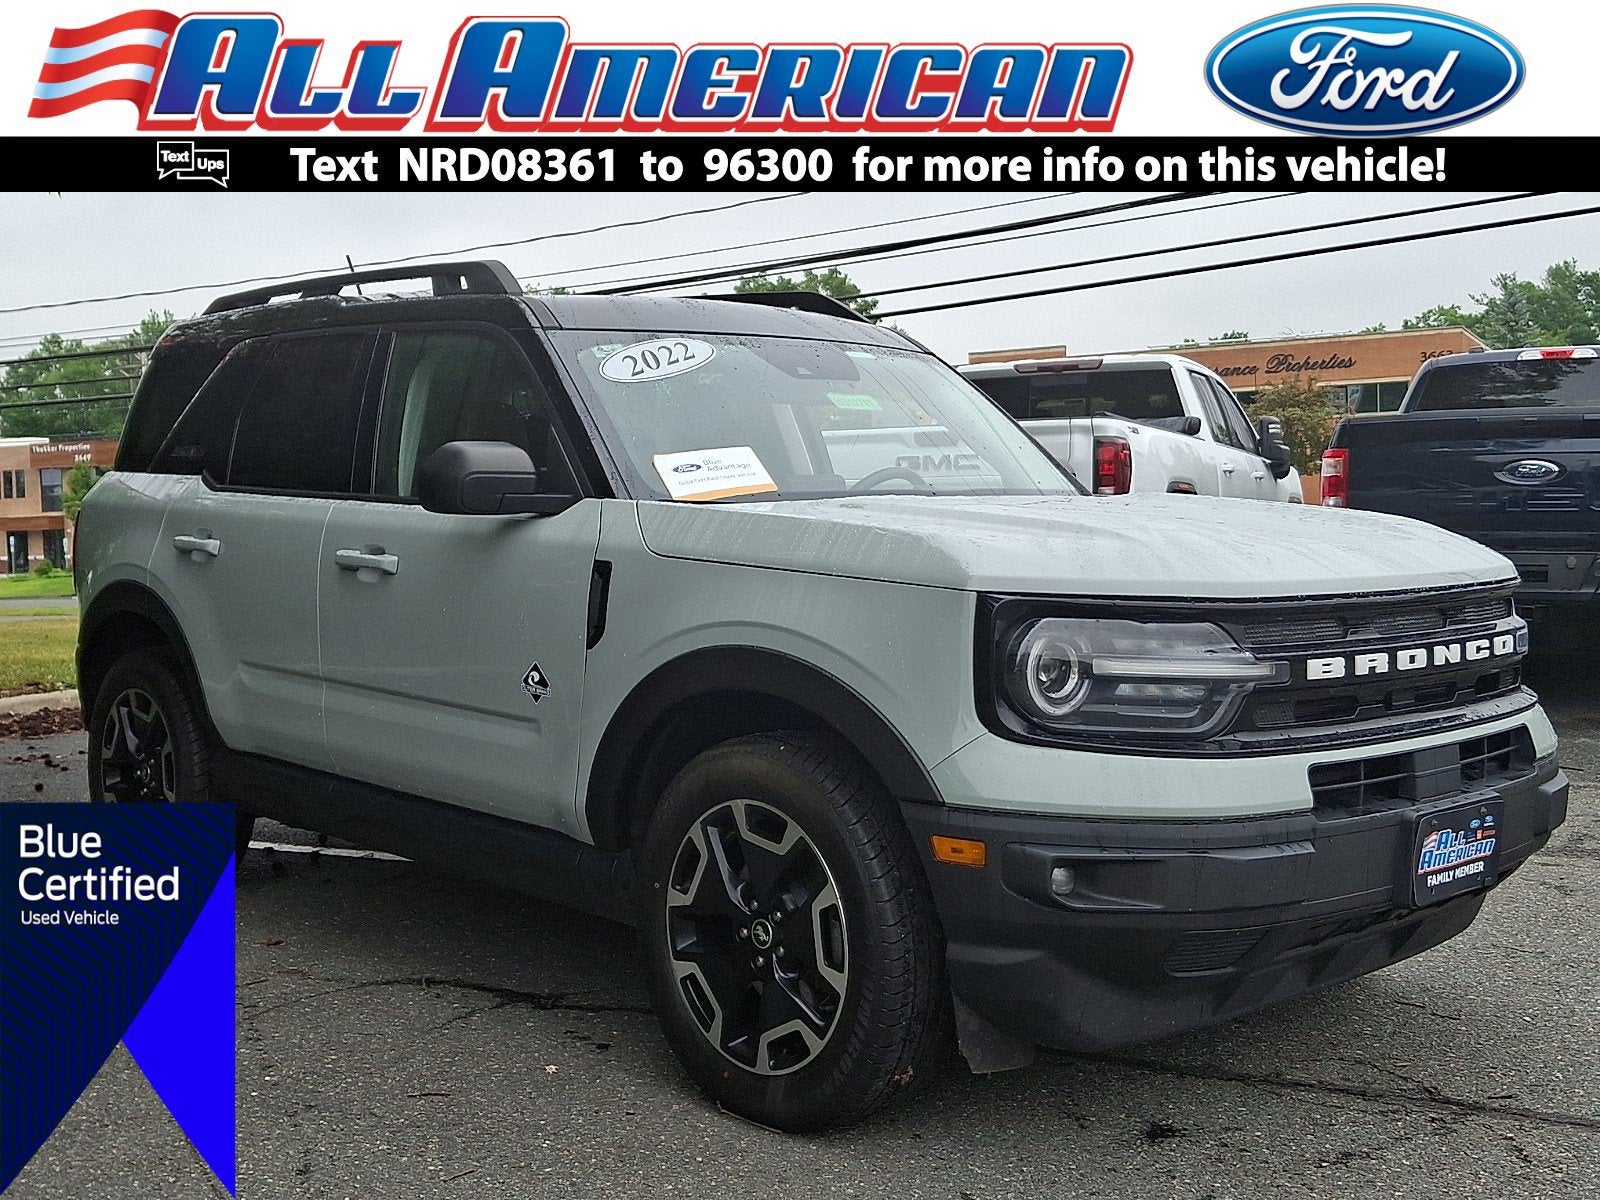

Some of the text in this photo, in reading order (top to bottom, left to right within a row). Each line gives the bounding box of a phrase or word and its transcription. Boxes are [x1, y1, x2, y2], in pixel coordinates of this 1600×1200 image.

[621, 341, 696, 378] 2022
[1264, 353, 1357, 374] Properties
[702, 459, 722, 467] Blue
[707, 462, 752, 472] Advantage
[894, 454, 980, 472] GMC
[1306, 634, 1514, 681] BRONCO
[1427, 861, 1485, 887] FAMILY MEMBER
